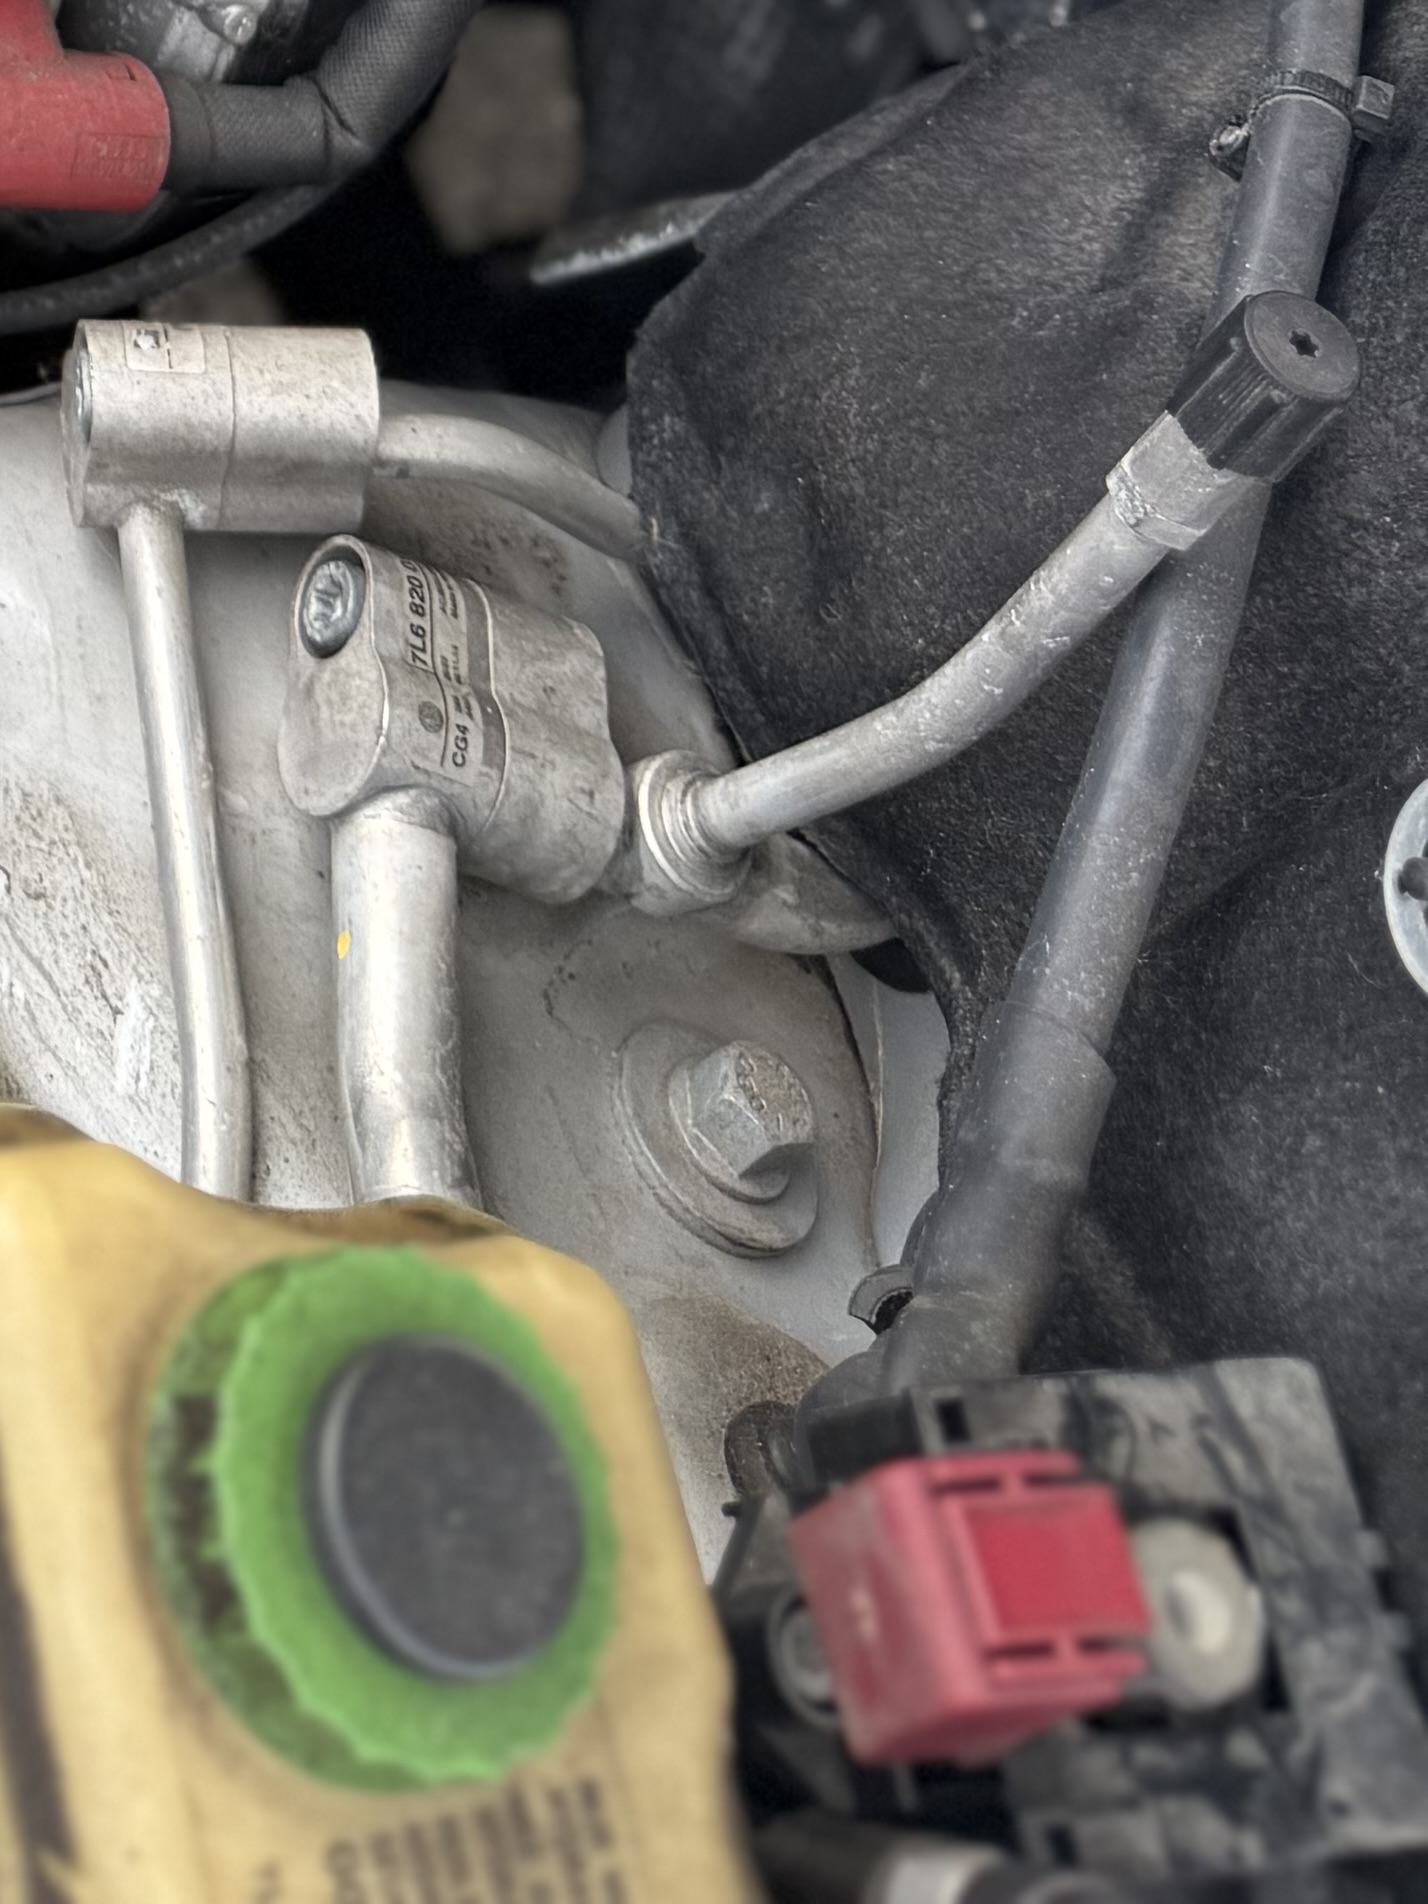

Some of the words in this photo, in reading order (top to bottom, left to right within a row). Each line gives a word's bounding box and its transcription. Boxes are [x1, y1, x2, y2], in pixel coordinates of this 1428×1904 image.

[407, 577, 425, 616] 820
[408, 623, 427, 665] 7L6
[451, 724, 470, 767] CG4
